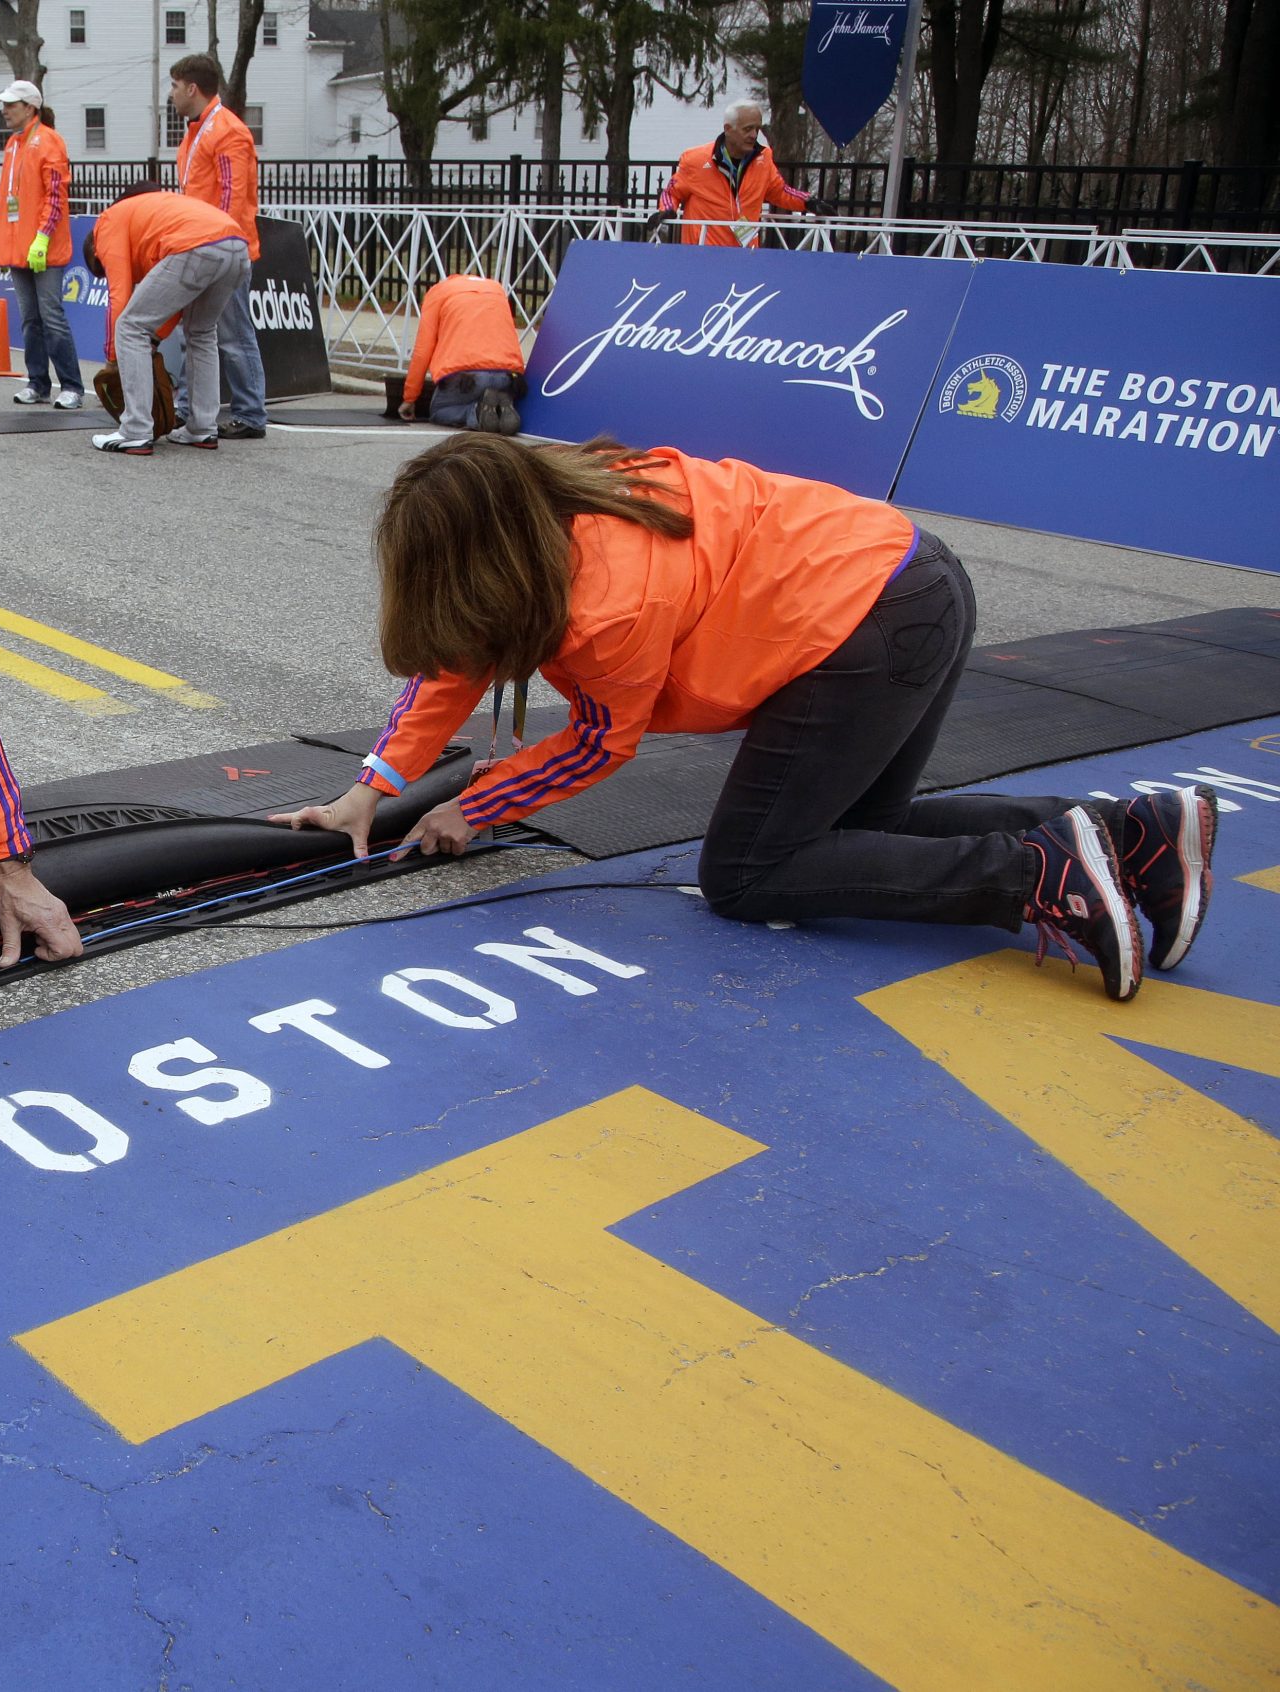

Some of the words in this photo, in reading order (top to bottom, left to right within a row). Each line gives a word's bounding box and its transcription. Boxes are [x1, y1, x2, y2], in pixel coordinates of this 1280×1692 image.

[817, 9, 852, 54] John
[850, 8, 895, 46] Hancock
[248, 278, 314, 331] adidas
[540, 278, 687, 397] John
[676, 282, 909, 421] Hancock
[942, 373, 962, 409] BOSTON
[960, 356, 1006, 376] ATHLETIC
[1003, 361, 1025, 417] ASSOCIATION
[1040, 363, 1110, 397] THE
[1118, 371, 1280, 418] BOSTON
[1025, 397, 1276, 458] MARATHON
